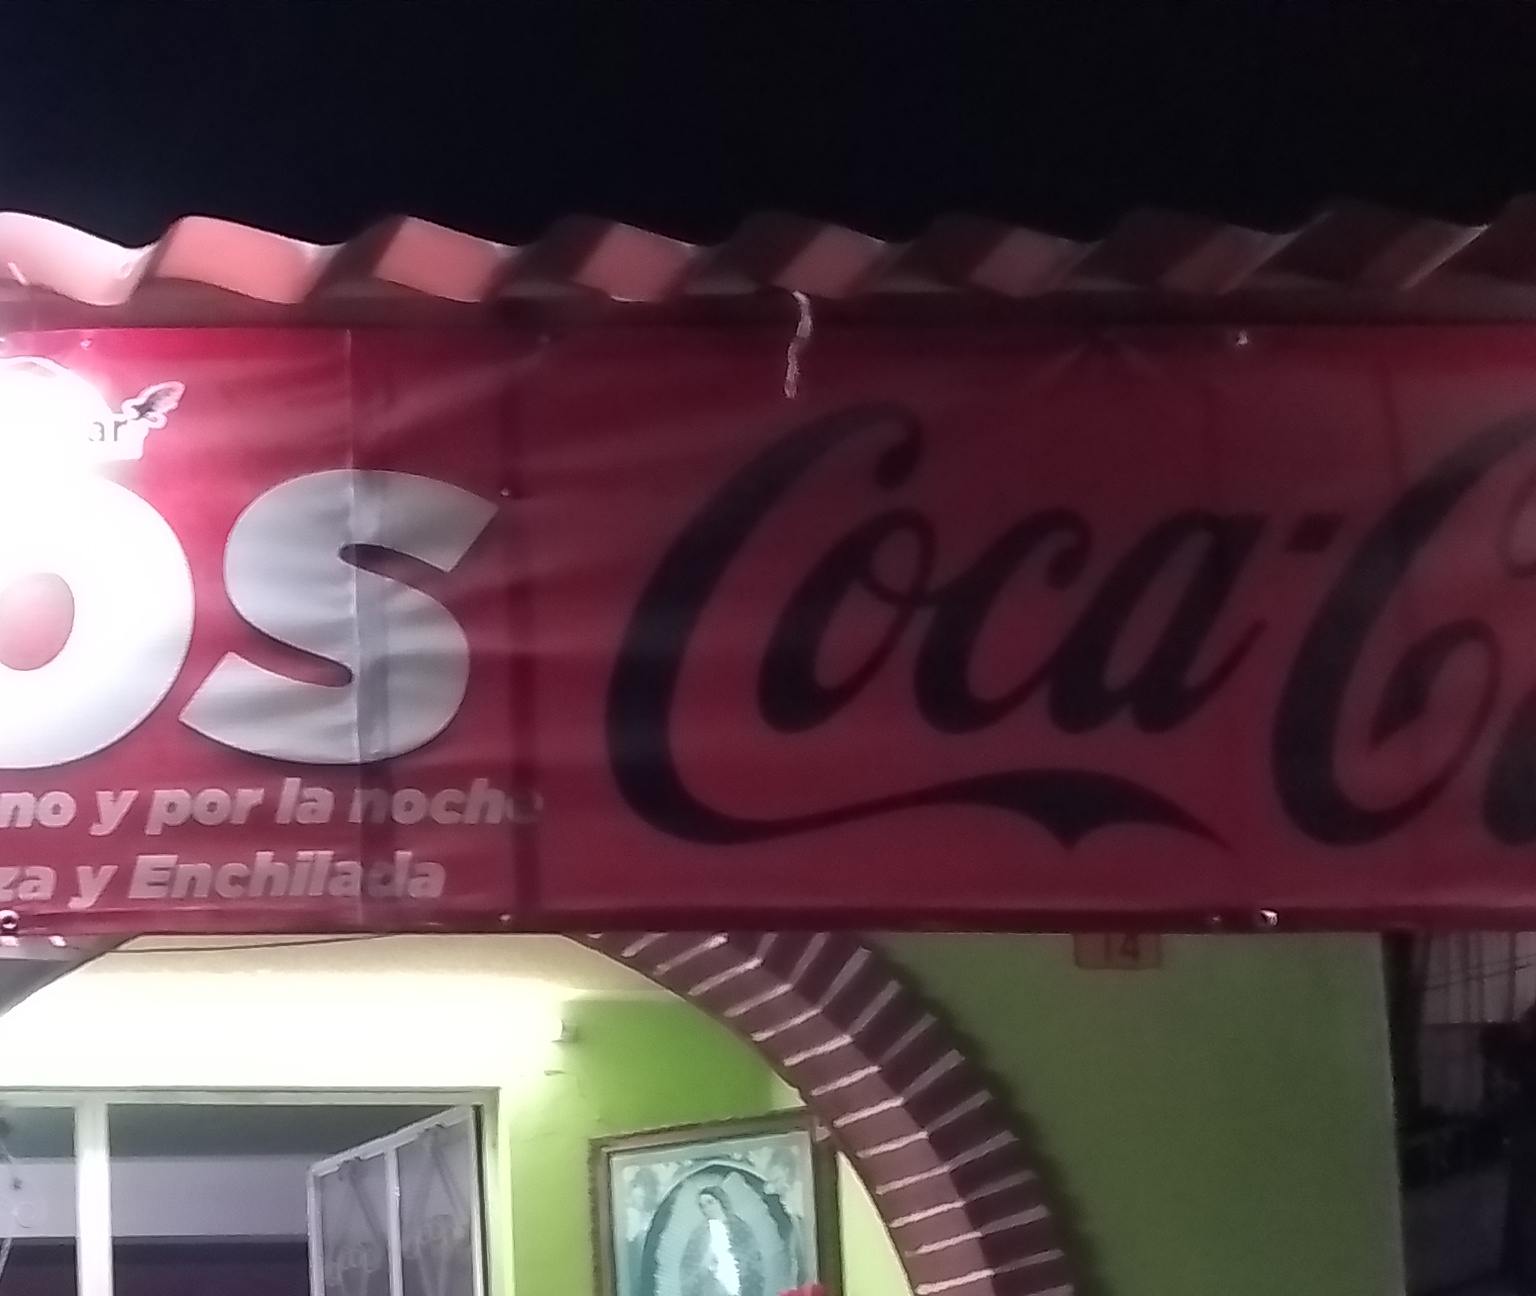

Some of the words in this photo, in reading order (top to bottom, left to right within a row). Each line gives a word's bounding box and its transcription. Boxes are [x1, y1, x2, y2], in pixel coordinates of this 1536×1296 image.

[89, 788, 138, 837] y
[143, 785, 266, 835] por
[273, 776, 335, 825] la
[68, 864, 119, 909] y
[128, 850, 447, 901] Enchilada
